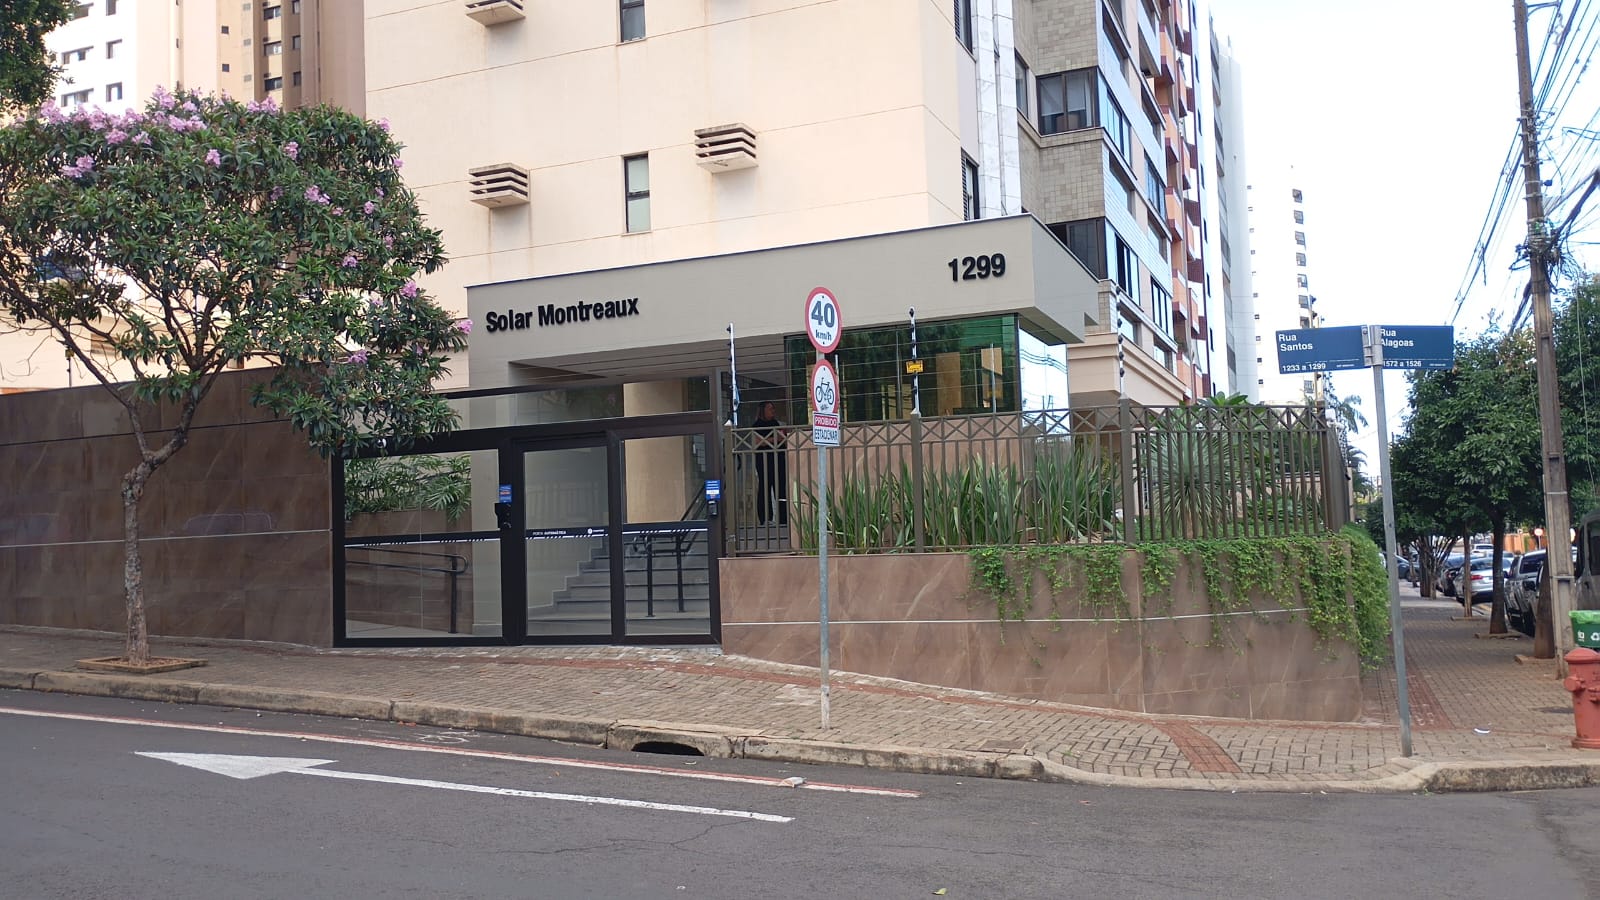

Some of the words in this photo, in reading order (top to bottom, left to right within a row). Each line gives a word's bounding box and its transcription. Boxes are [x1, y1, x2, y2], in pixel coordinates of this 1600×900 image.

[947, 252, 1006, 282] 1299
[486, 309, 533, 333] Solar
[538, 298, 639, 327] Montreaux
[811, 300, 836, 328] 40
[815, 328, 832, 341] km/h
[1278, 333, 1297, 342] Rua
[1380, 328, 1397, 337] Rua
[1280, 343, 1314, 352] Santos
[1381, 338, 1414, 349] Alagoas
[1282, 364, 1300, 372] 1233
[1308, 362, 1326, 371] 1299
[815, 415, 837, 427] PROIBIDO
